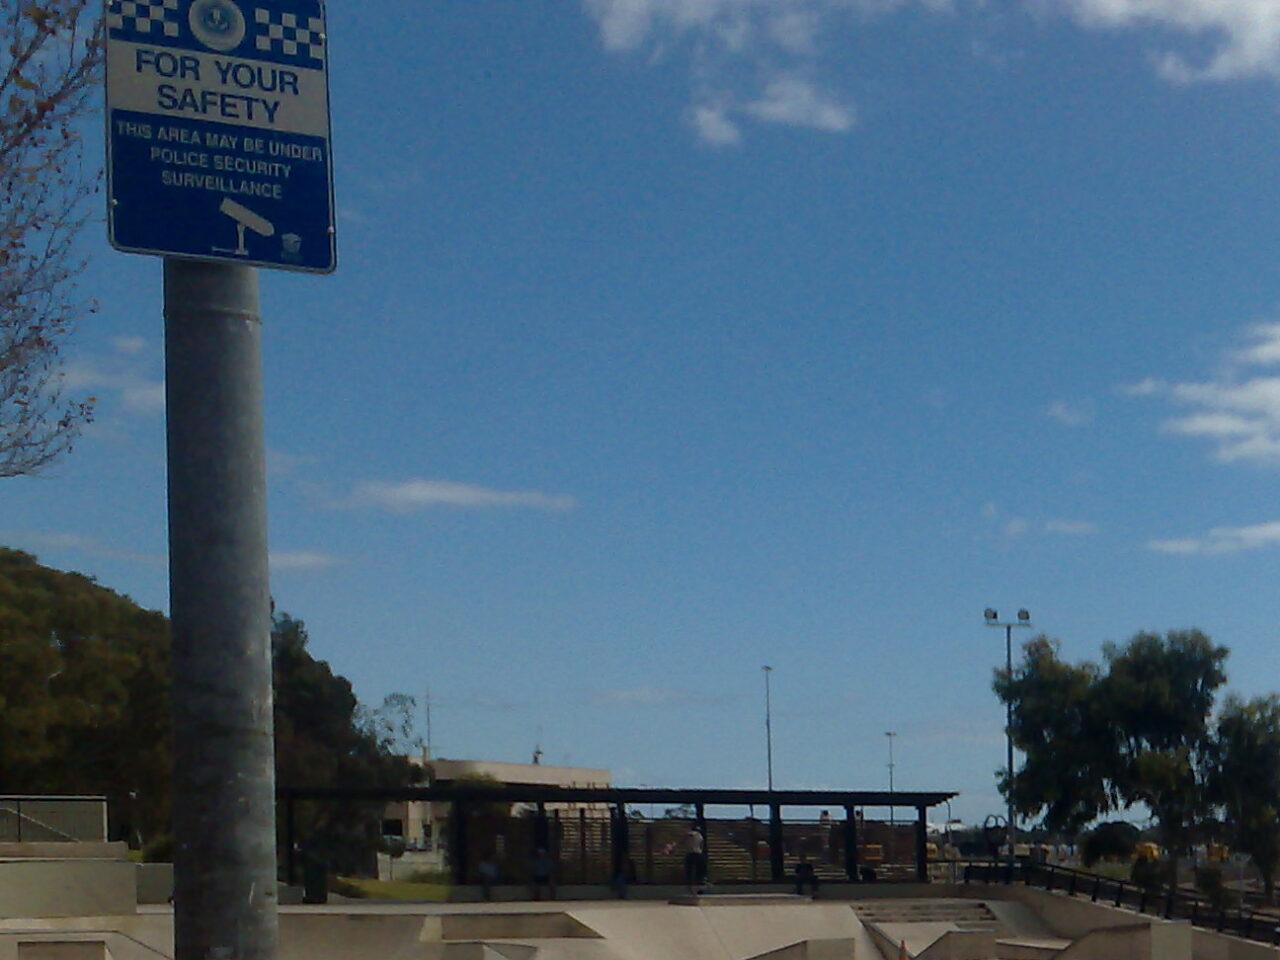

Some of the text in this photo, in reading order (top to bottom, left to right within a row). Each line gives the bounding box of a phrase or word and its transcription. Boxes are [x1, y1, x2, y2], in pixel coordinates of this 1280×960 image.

[135, 49, 299, 95] FOR YOUR
[157, 84, 280, 123] SAFETY
[116, 120, 323, 162] THIS AREA MAY BE UNDER
[151, 147, 292, 178] POLICE SECURITY
[161, 170, 283, 199] SURVEILLANCE
